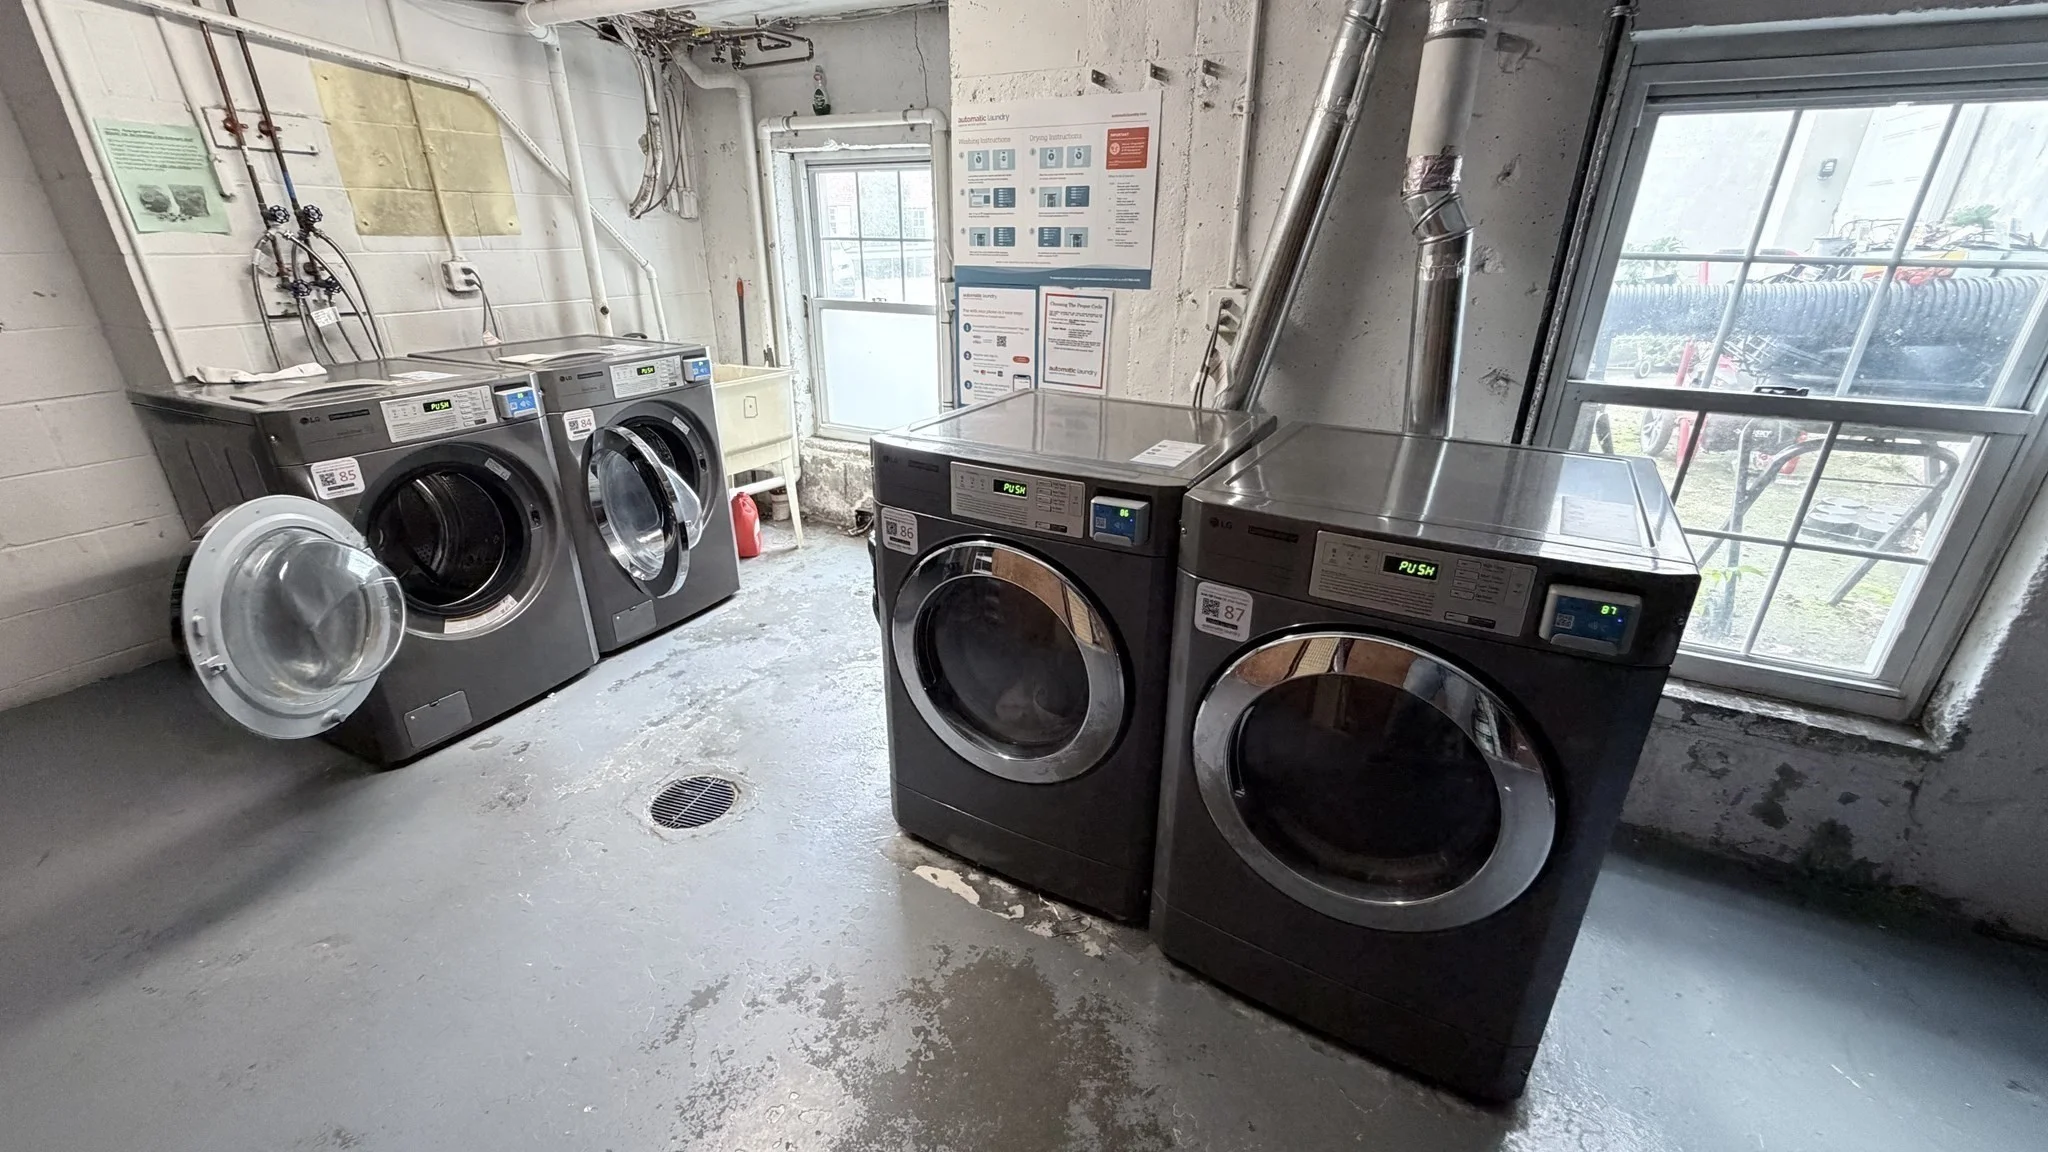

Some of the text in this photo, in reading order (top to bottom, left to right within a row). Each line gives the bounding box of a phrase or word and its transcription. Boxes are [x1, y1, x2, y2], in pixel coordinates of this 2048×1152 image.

[958, 115, 987, 123] automatic
[1029, 133, 1082, 142] Drying Instructions
[1049, 366, 1076, 374] automatic
[430, 401, 450, 410] PUSH
[581, 418, 592, 428] 84
[339, 469, 356, 482] 85
[1003, 482, 1026, 495] PUSH
[1120, 509, 1129, 517] 86
[900, 525, 914, 539] 86
[1399, 560, 1436, 577] PUSH
[1224, 605, 1246, 622] 87
[1601, 605, 1618, 616] 87
